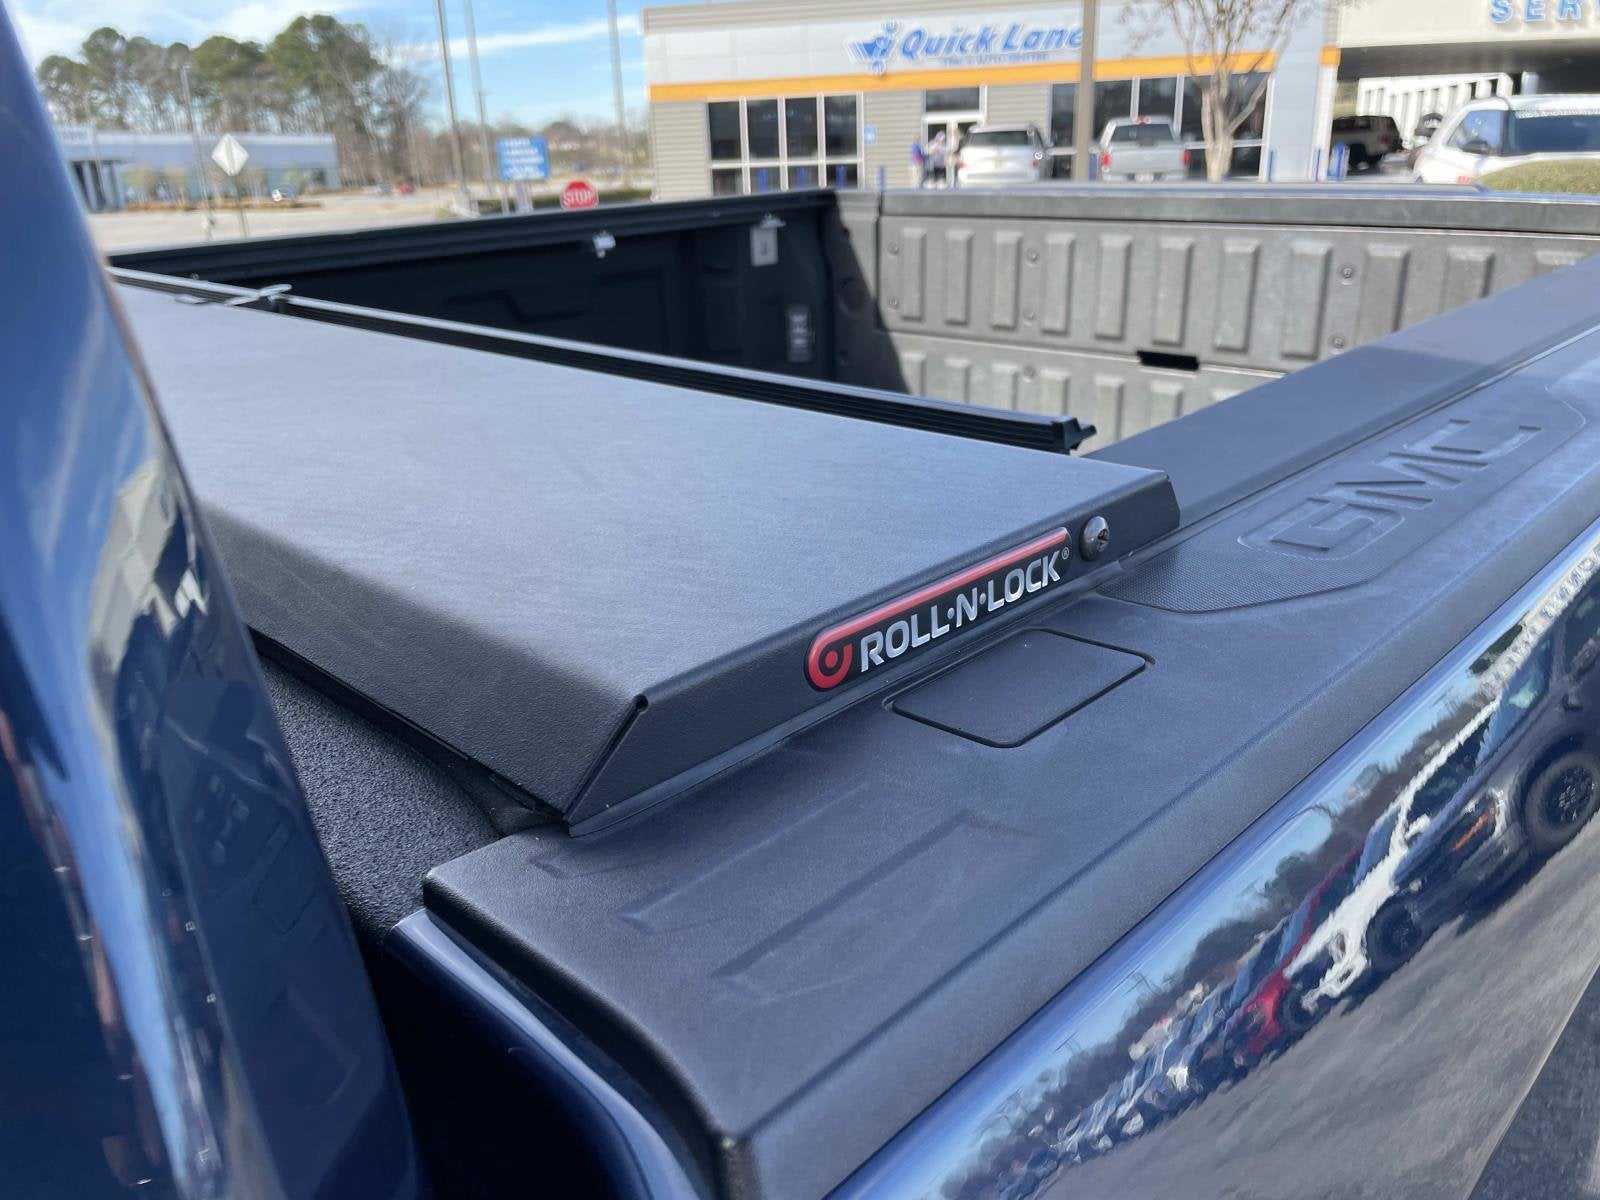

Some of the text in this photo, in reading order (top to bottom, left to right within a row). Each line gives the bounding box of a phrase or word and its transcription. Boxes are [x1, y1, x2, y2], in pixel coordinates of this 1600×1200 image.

[1490, 0, 1600, 23] SER
[901, 24, 1083, 60] Quick Lane
[564, 190, 594, 205] STOP
[1237, 418, 1542, 561] GMC
